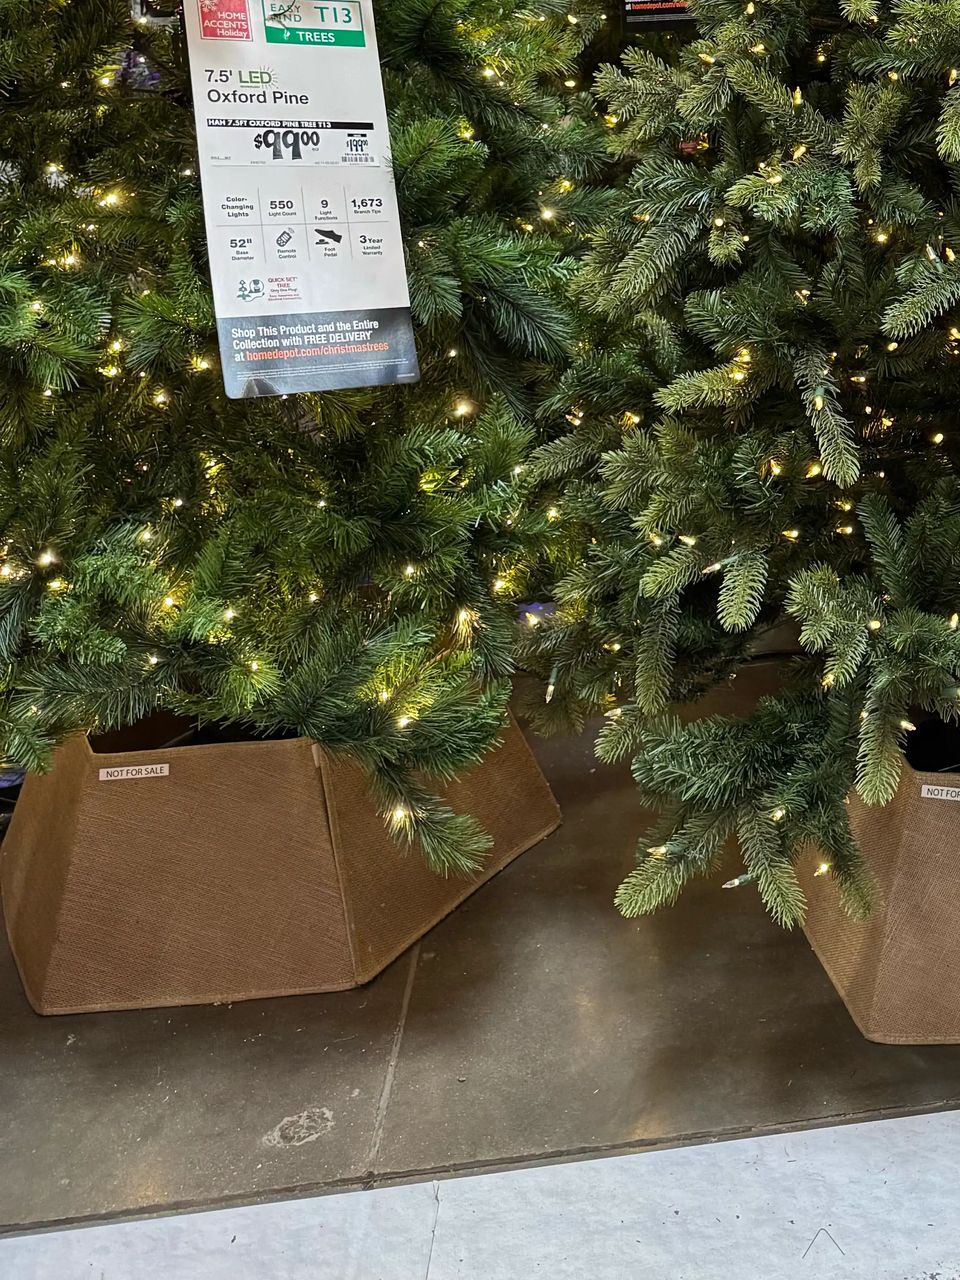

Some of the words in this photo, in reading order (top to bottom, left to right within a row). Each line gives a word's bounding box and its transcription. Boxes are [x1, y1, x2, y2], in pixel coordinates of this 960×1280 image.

[270, 4, 301, 13] EASY
[218, 12, 246, 20] HOME
[314, 6, 352, 24] T13
[204, 20, 247, 29] ACCENTS
[217, 29, 248, 38] Holiday
[296, 31, 335, 43] TREES
[204, 70, 232, 83] 7.5'
[238, 71, 272, 84] LED
[208, 89, 267, 104] Oxford
[273, 91, 309, 105] Pine
[270, 200, 294, 209] 550
[321, 200, 328, 208] 9
[351, 199, 382, 209] 1,673
[230, 239, 252, 248] 52"
[360, 235, 367, 243] 3
[232, 327, 255, 339] Shop
[257, 326, 278, 336] This
[280, 324, 316, 335] Product
[318, 322, 334, 332] and
[337, 321, 351, 331] the
[353, 320, 379, 330] Entire
[233, 337, 280, 350] Collection
[282, 335, 302, 346] with
[305, 334, 328, 345] FREE
[235, 352, 244, 362] at
[247, 341, 389, 361] homedepot.com/christmastrees
[106, 769, 125, 778] NOT
[126, 768, 143, 776] FOR
[145, 766, 164, 775] SALE
[926, 788, 944, 796] NOT
